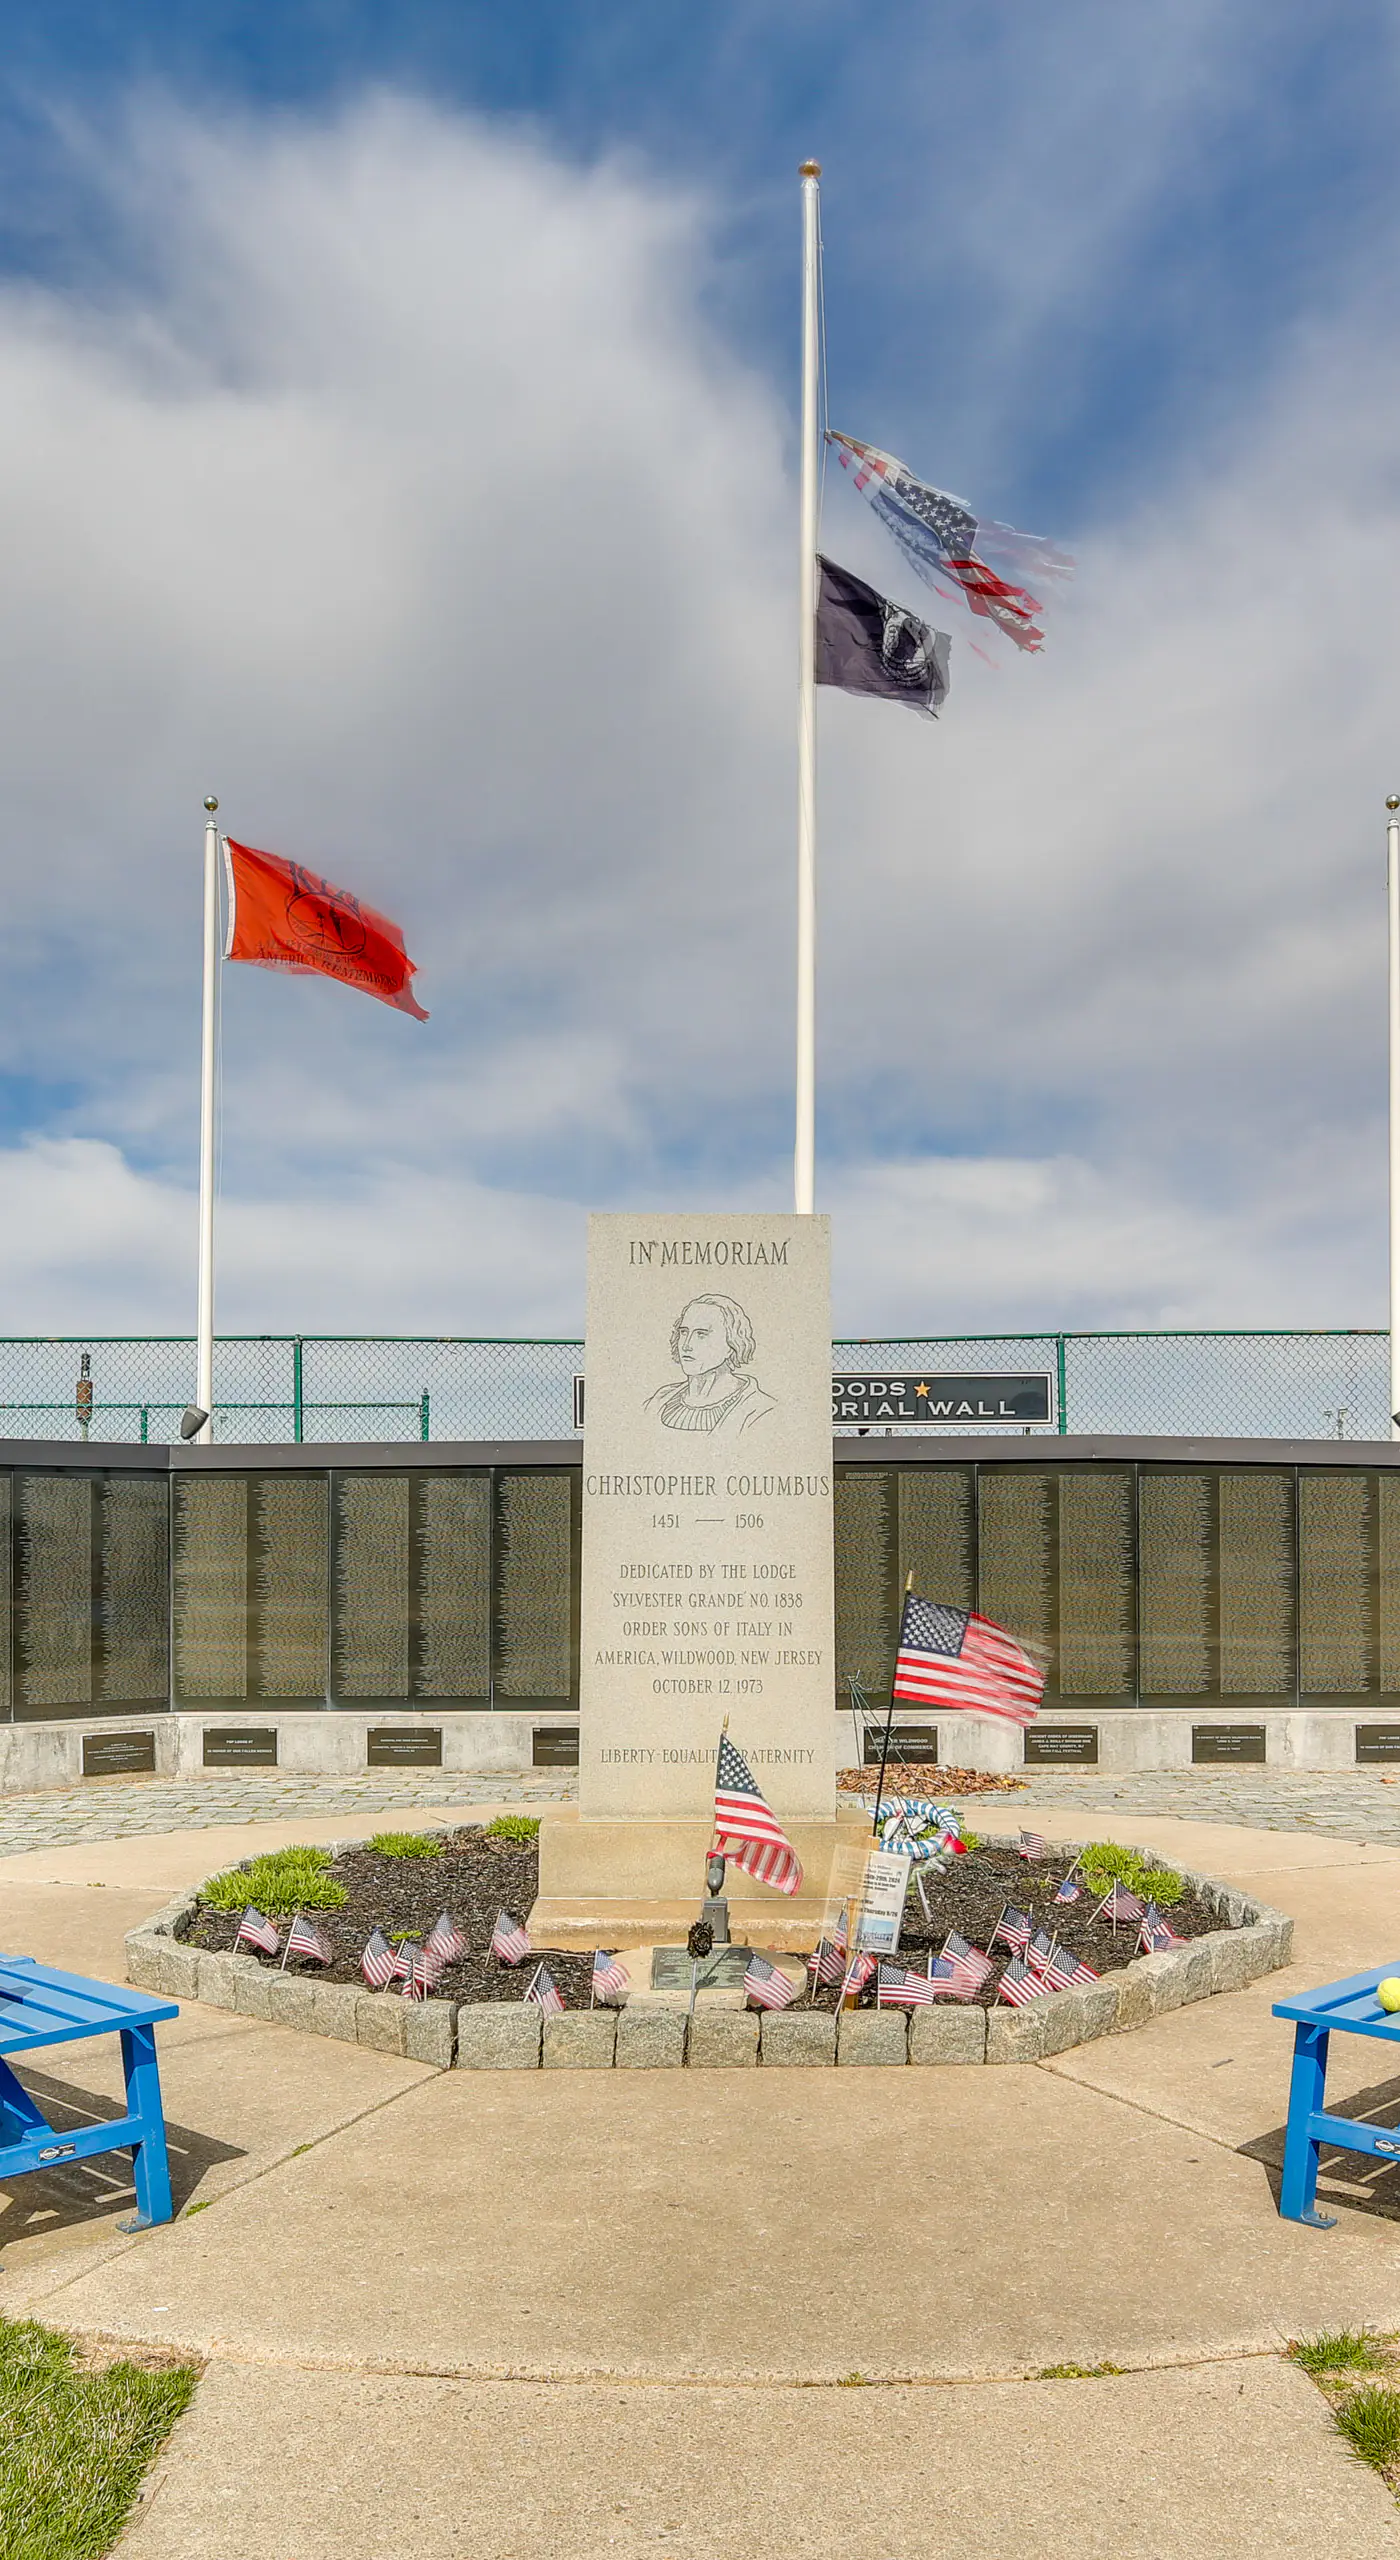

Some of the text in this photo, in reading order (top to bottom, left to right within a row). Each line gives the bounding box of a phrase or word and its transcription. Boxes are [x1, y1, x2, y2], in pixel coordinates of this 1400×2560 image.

[629, 1241, 789, 1266] IN MEMORIAM
[927, 1401, 1016, 1416] WALL
[586, 1475, 830, 1497] CHRISTOPHER COLUMBUS
[652, 1514, 680, 1528] 1451
[735, 1514, 764, 1528] 1506
[620, 1564, 797, 1579] DEDICATED BY THE LODGE
[750, 1593, 770, 1608] NO.
[774, 1593, 803, 1608] 1838
[623, 1621, 793, 1636] ORDER SONS OF ITALY IN
[595, 1650, 823, 1666] AMERICA, WILDWOOD, NEW JERSEY
[652, 1679, 713, 1694] OCTOBER
[736, 1679, 763, 1694] 1973
[737, 1749, 815, 1764] RATERNITY
